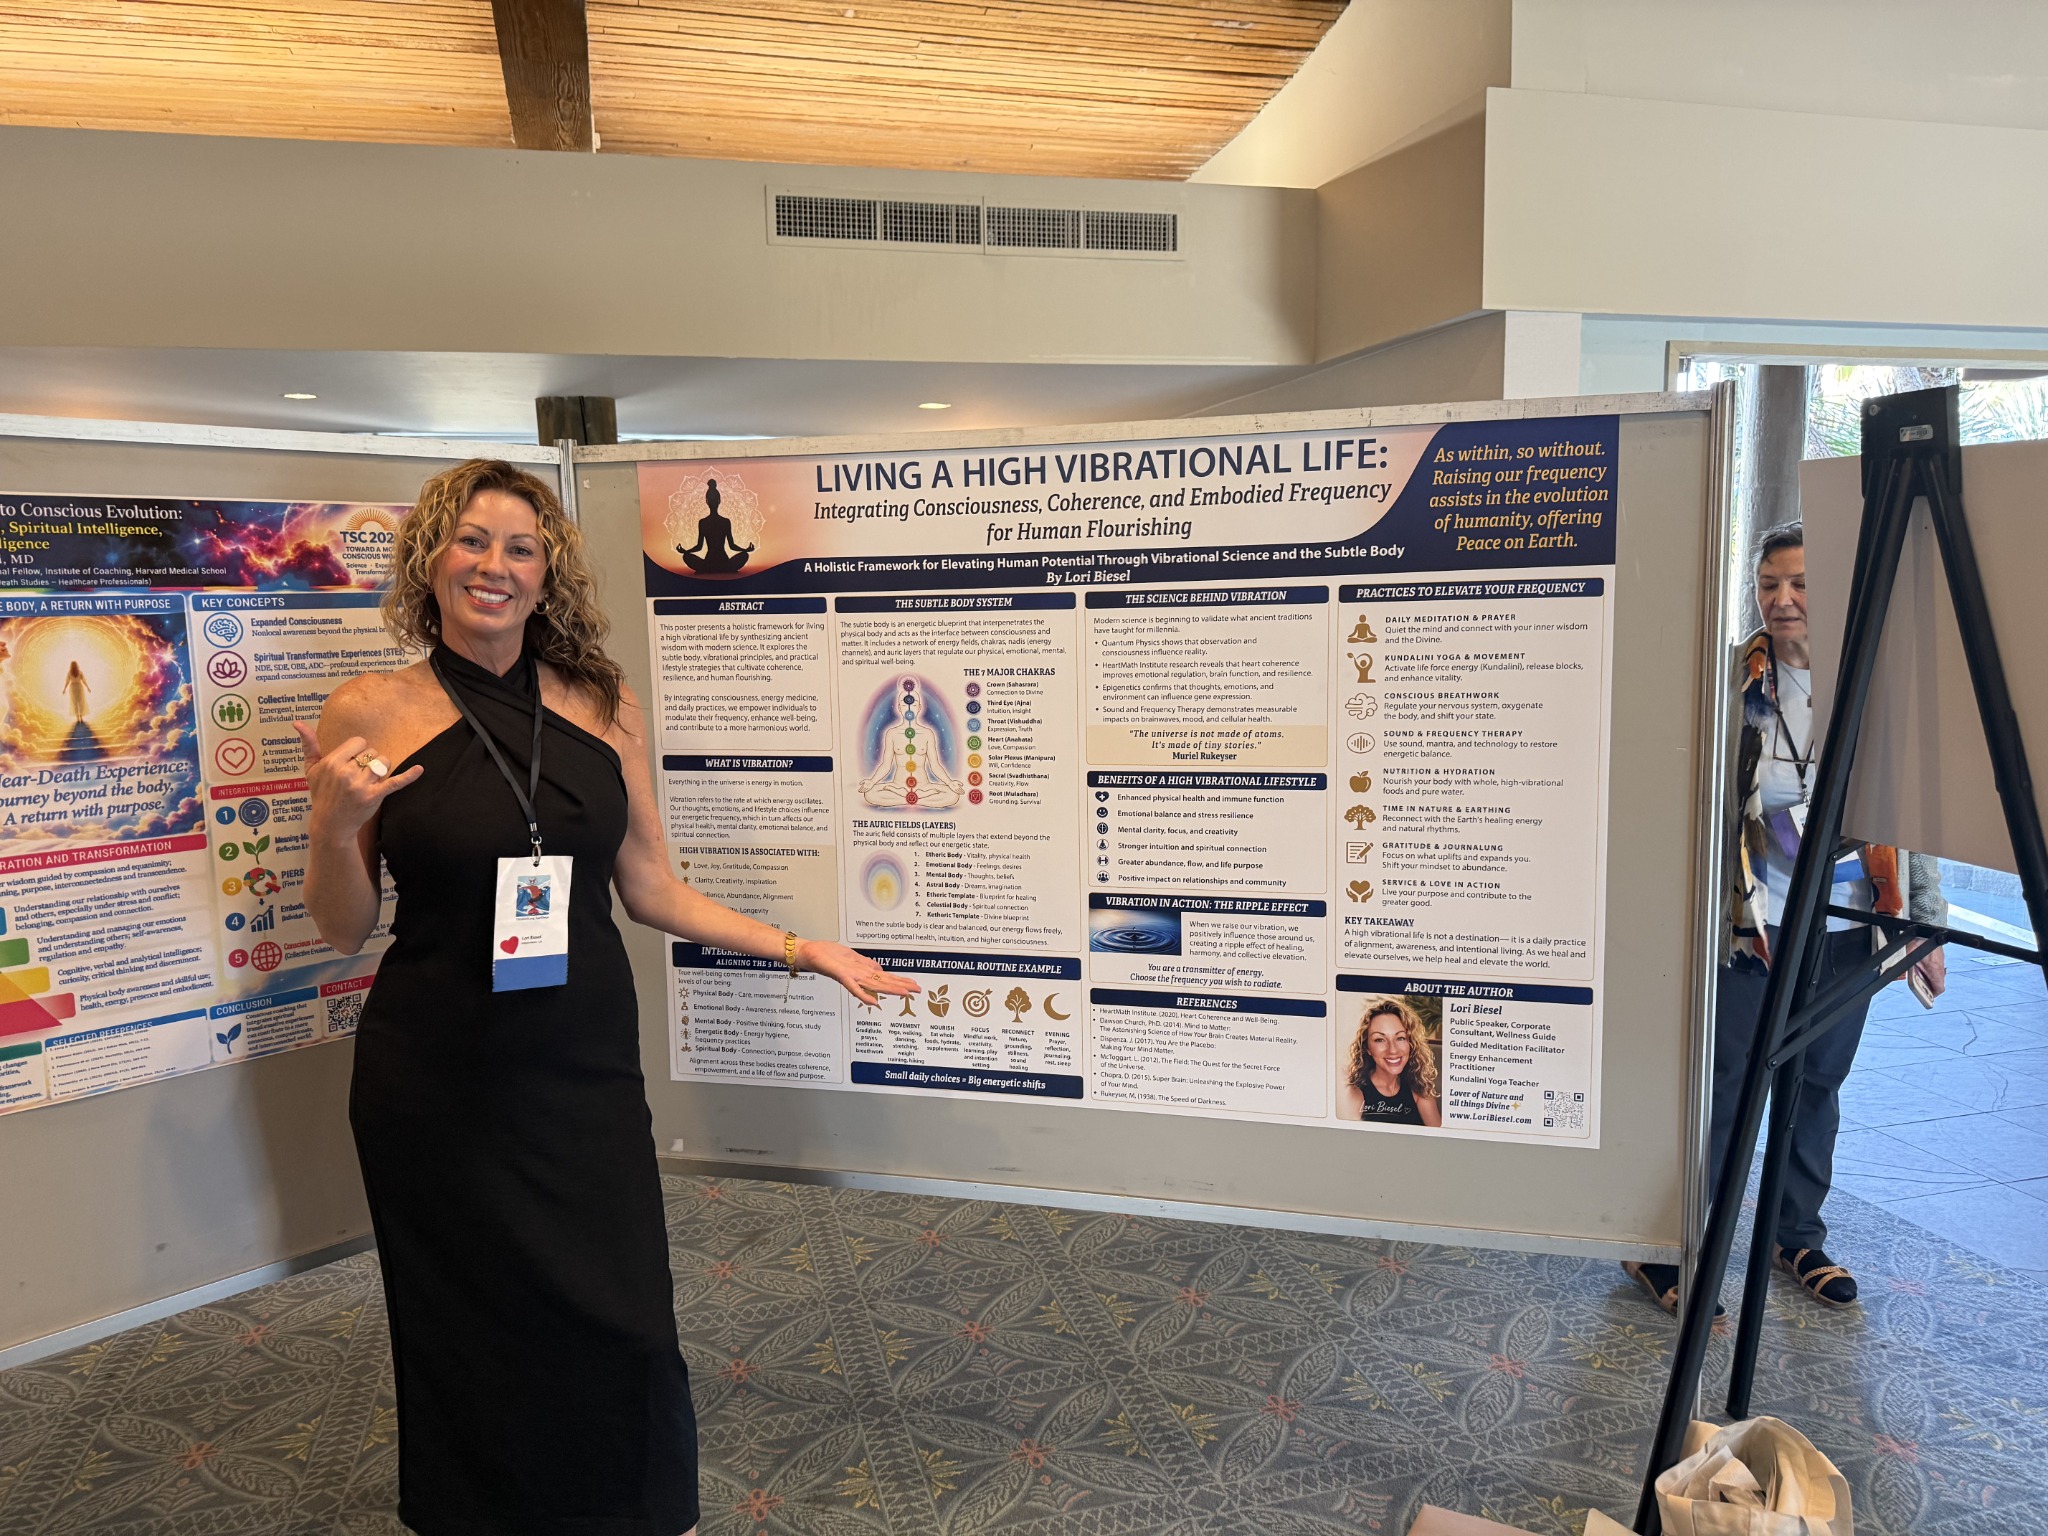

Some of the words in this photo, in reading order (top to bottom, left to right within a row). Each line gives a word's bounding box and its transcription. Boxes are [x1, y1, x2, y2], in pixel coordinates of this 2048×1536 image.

[1433, 447, 1454, 462] As
[1457, 444, 1512, 461] within,
[1516, 447, 1534, 459] so
[1537, 441, 1605, 457] without.
[816, 462, 922, 492] LIVING
[930, 460, 954, 488] A
[963, 456, 1046, 486] HIGH
[1054, 444, 1292, 482] VIBRATIONAL
[1303, 438, 1388, 471] LIFE:
[1432, 468, 1492, 486] Raising
[1494, 470, 1524, 482] our
[1525, 465, 1607, 484] frequency
[813, 500, 909, 523] Integrating
[913, 497, 1042, 516] Consciousness,
[1047, 493, 1144, 511] Coherence,
[1149, 487, 1186, 507] and
[1189, 483, 1284, 506] Embodied
[1288, 483, 1392, 504] Frequency
[1429, 491, 1482, 507] assists
[1485, 490, 1500, 505] in
[1504, 488, 1530, 504] the
[1533, 486, 1608, 503] evolution
[0, 503, 16, 516] to
[20, 502, 102, 518] Conscious
[105, 505, 182, 521] Evolution:
[1434, 513, 1452, 533] of
[1453, 512, 1533, 529] humanity,
[1537, 509, 1602, 528] offering
[8, 521, 73, 536] Spiritual
[76, 522, 162, 537] Intelligence,
[986, 523, 1013, 545] for
[1016, 522, 1082, 540] Human
[1085, 517, 1192, 539] Flourishing
[339, 532, 367, 543] TSC
[1455, 536, 1501, 550] Peace
[1504, 537, 1524, 549] on
[1527, 532, 1578, 548] Earth.
[10, 554, 34, 564] MD
[804, 562, 812, 572] A
[814, 561, 856, 572] Holistic
[857, 560, 920, 571] Framework
[922, 559, 939, 570] for
[941, 558, 994, 571] Elevating
[997, 557, 1039, 568] Human
[1041, 555, 1095, 566] Potential
[1096, 553, 1148, 567] Through
[1150, 551, 1219, 563] Vibrational
[1222, 550, 1270, 561] Science
[1272, 548, 1297, 559] and
[1299, 547, 1322, 559] the
[1324, 546, 1367, 558] Subtle
[1370, 544, 1405, 558] Body
[12, 567, 43, 575] Fellow,
[44, 567, 81, 575] Institute
[92, 567, 134, 576] Coaching,
[1046, 572, 1063, 585] By
[1065, 571, 1091, 583] Lori
[1094, 570, 1130, 581] Biesel
[1125, 594, 1145, 603] THE
[1146, 593, 1188, 603] SCIENCE
[1189, 592, 1228, 602] BEHIND
[1230, 591, 1287, 601] VIBRATION
[1356, 587, 1416, 598] PRACTICES
[1417, 586, 1433, 596] TO
[1434, 584, 1482, 596] ELEVATE
[1484, 584, 1515, 594] YOUR
[1516, 582, 1586, 595] FREQUENCY
[6, 601, 38, 612] BODY,
[40, 601, 48, 611] A
[50, 600, 93, 610] RETURN
[94, 599, 122, 609] WITH
[124, 599, 170, 609] PURPOSE
[201, 598, 223, 608] KEY
[226, 597, 285, 607] CONCEPTS
[718, 601, 764, 610] ABSTRACT
[895, 599, 913, 608] THE
[914, 598, 949, 608] SUBTLE
[950, 598, 975, 607] BODY
[976, 597, 1012, 607] SYSTEM
[250, 617, 287, 628] Expanded
[288, 617, 343, 625] Consciousness
[1481, 613, 1516, 621] PRAYER
[254, 652, 285, 663] Spiritual
[286, 650, 339, 660] Transformative
[341, 649, 382, 660] Experiences
[1473, 652, 1525, 660] MOVEMENT
[1172, 751, 1198, 760] Muriel
[1200, 751, 1237, 761] Rukeyser
[95, 760, 189, 781] Experience:
[705, 759, 732, 768] WHAT
[732, 759, 741, 768] IS
[742, 759, 793, 769] VIBRATION?
[1098, 775, 1143, 785] BENEFITS
[1144, 776, 1157, 785] OF
[1159, 776, 1166, 785] A
[1167, 776, 1193, 785] HIGH
[1195, 776, 1262, 786] VIBRATIONAL
[1263, 776, 1317, 786] LIFESTYLE
[53, 785, 107, 804] beyond
[110, 783, 134, 796] the
[136, 779, 174, 797] body,
[4, 812, 17, 826] A
[20, 808, 68, 824] return
[71, 803, 103, 818] with
[105, 799, 165, 818] purpose.
[46, 852, 69, 864] AND
[73, 841, 172, 860] TRANSFORMATION
[1105, 896, 1158, 907] VIBRATION
[1158, 898, 1171, 907] IN
[1172, 899, 1212, 909] ACTION:
[1213, 900, 1234, 909] THE
[1234, 901, 1270, 911] RIPPLE
[1270, 902, 1309, 912] EFFECT
[1344, 916, 1362, 924] KEY
[1363, 917, 1414, 926] TAKEAWAY
[326, 980, 363, 993] CONTACT
[1404, 983, 1443, 993] ABOUT
[1444, 985, 1466, 995] THE
[1467, 986, 1513, 997] AUTHOR
[216, 998, 272, 1015] CONCLUSION
[1176, 997, 1238, 1009] REFERENCES
[1450, 1003, 1472, 1013] Lori
[1472, 1004, 1502, 1015] Biesel
[1450, 1017, 1474, 1026] Public
[1475, 1019, 1509, 1028] Speaker,
[1510, 1021, 1551, 1030] Corporate
[1449, 1040, 1478, 1048] Guided
[1479, 1042, 1524, 1051] Meditation
[1524, 1044, 1565, 1053] Facilitator
[884, 1070, 908, 1079] Small
[909, 1071, 929, 1081] daily
[930, 1073, 960, 1083] choices
[967, 1075, 982, 1086] Big
[982, 1078, 1021, 1088] energetic
[1022, 1079, 1046, 1090] shifts
[1449, 1113, 1532, 1124] www.LoriBiesel.com
